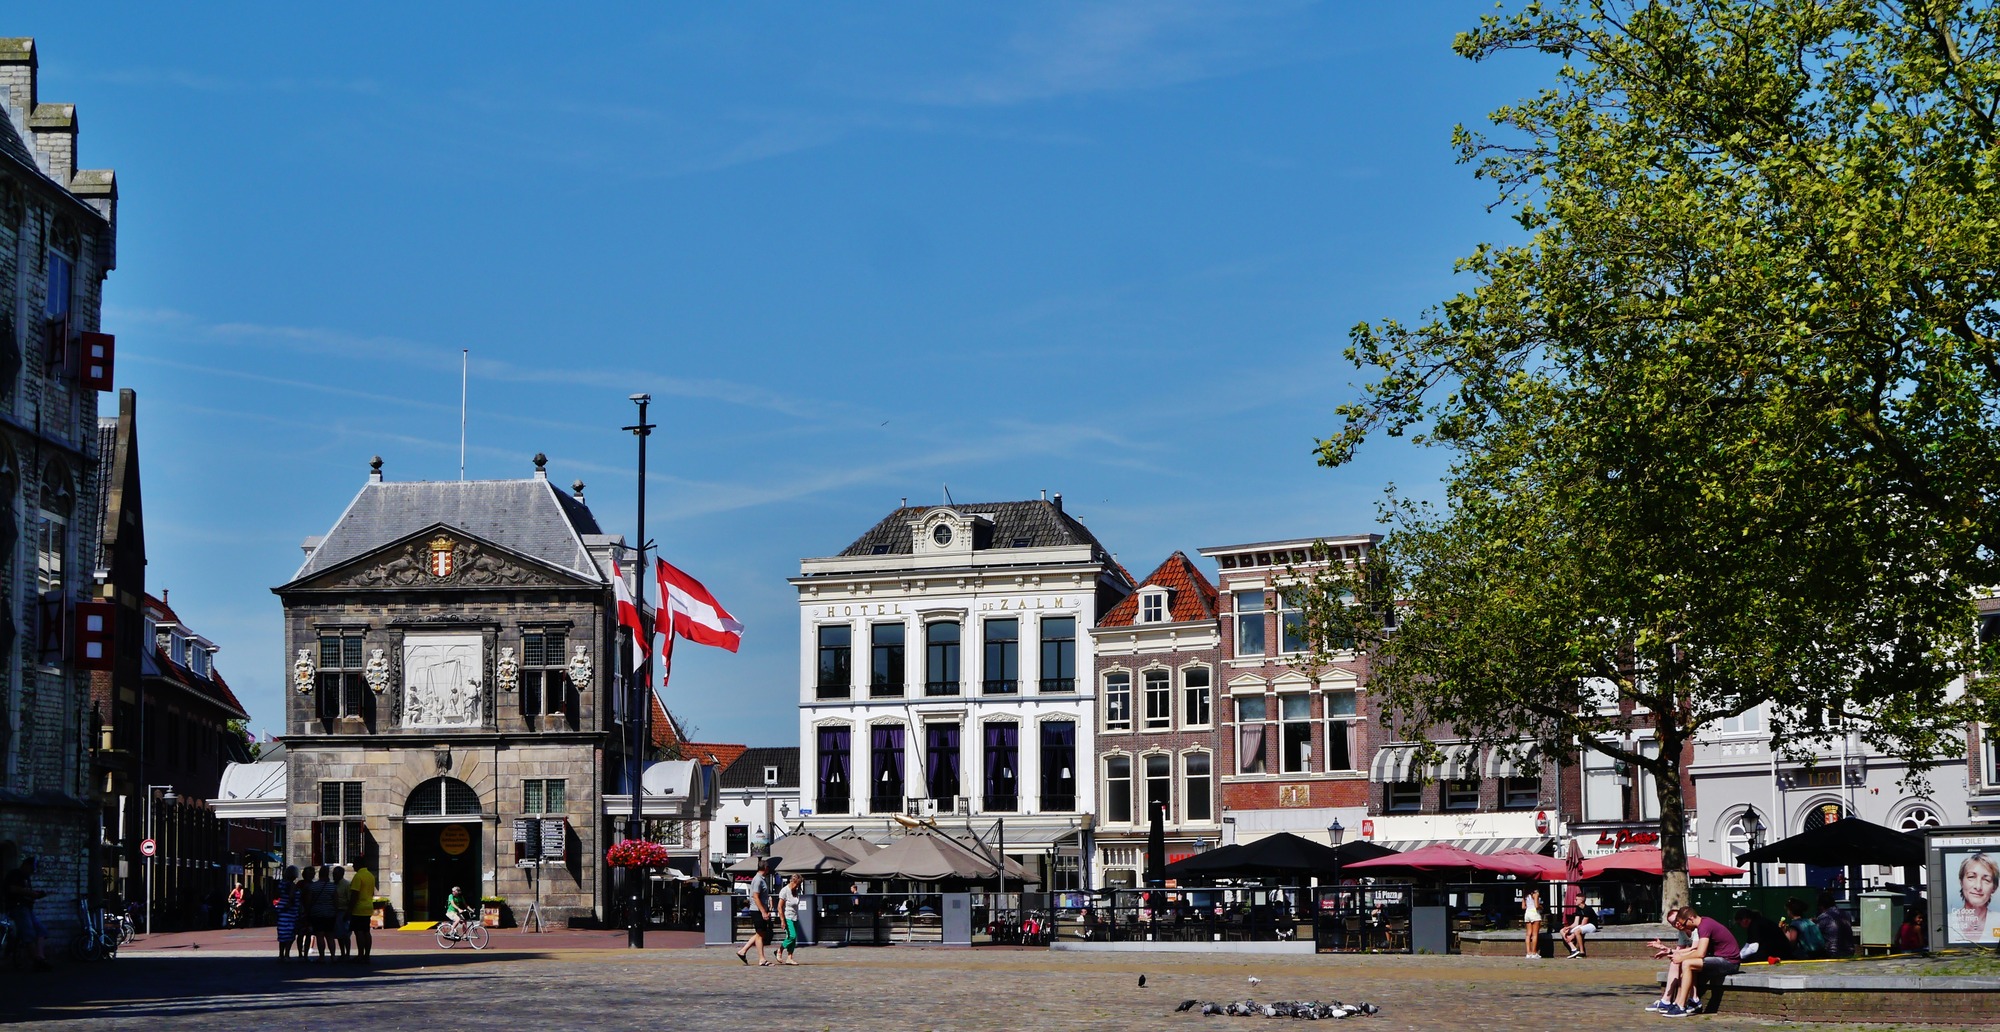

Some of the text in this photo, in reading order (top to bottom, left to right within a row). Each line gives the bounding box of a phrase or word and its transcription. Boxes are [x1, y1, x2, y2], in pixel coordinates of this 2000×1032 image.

[827, 597, 1064, 617] HOTEL DE ZALM
[1596, 828, 1659, 849] La Piazza
[1515, 888, 1523, 897] La
